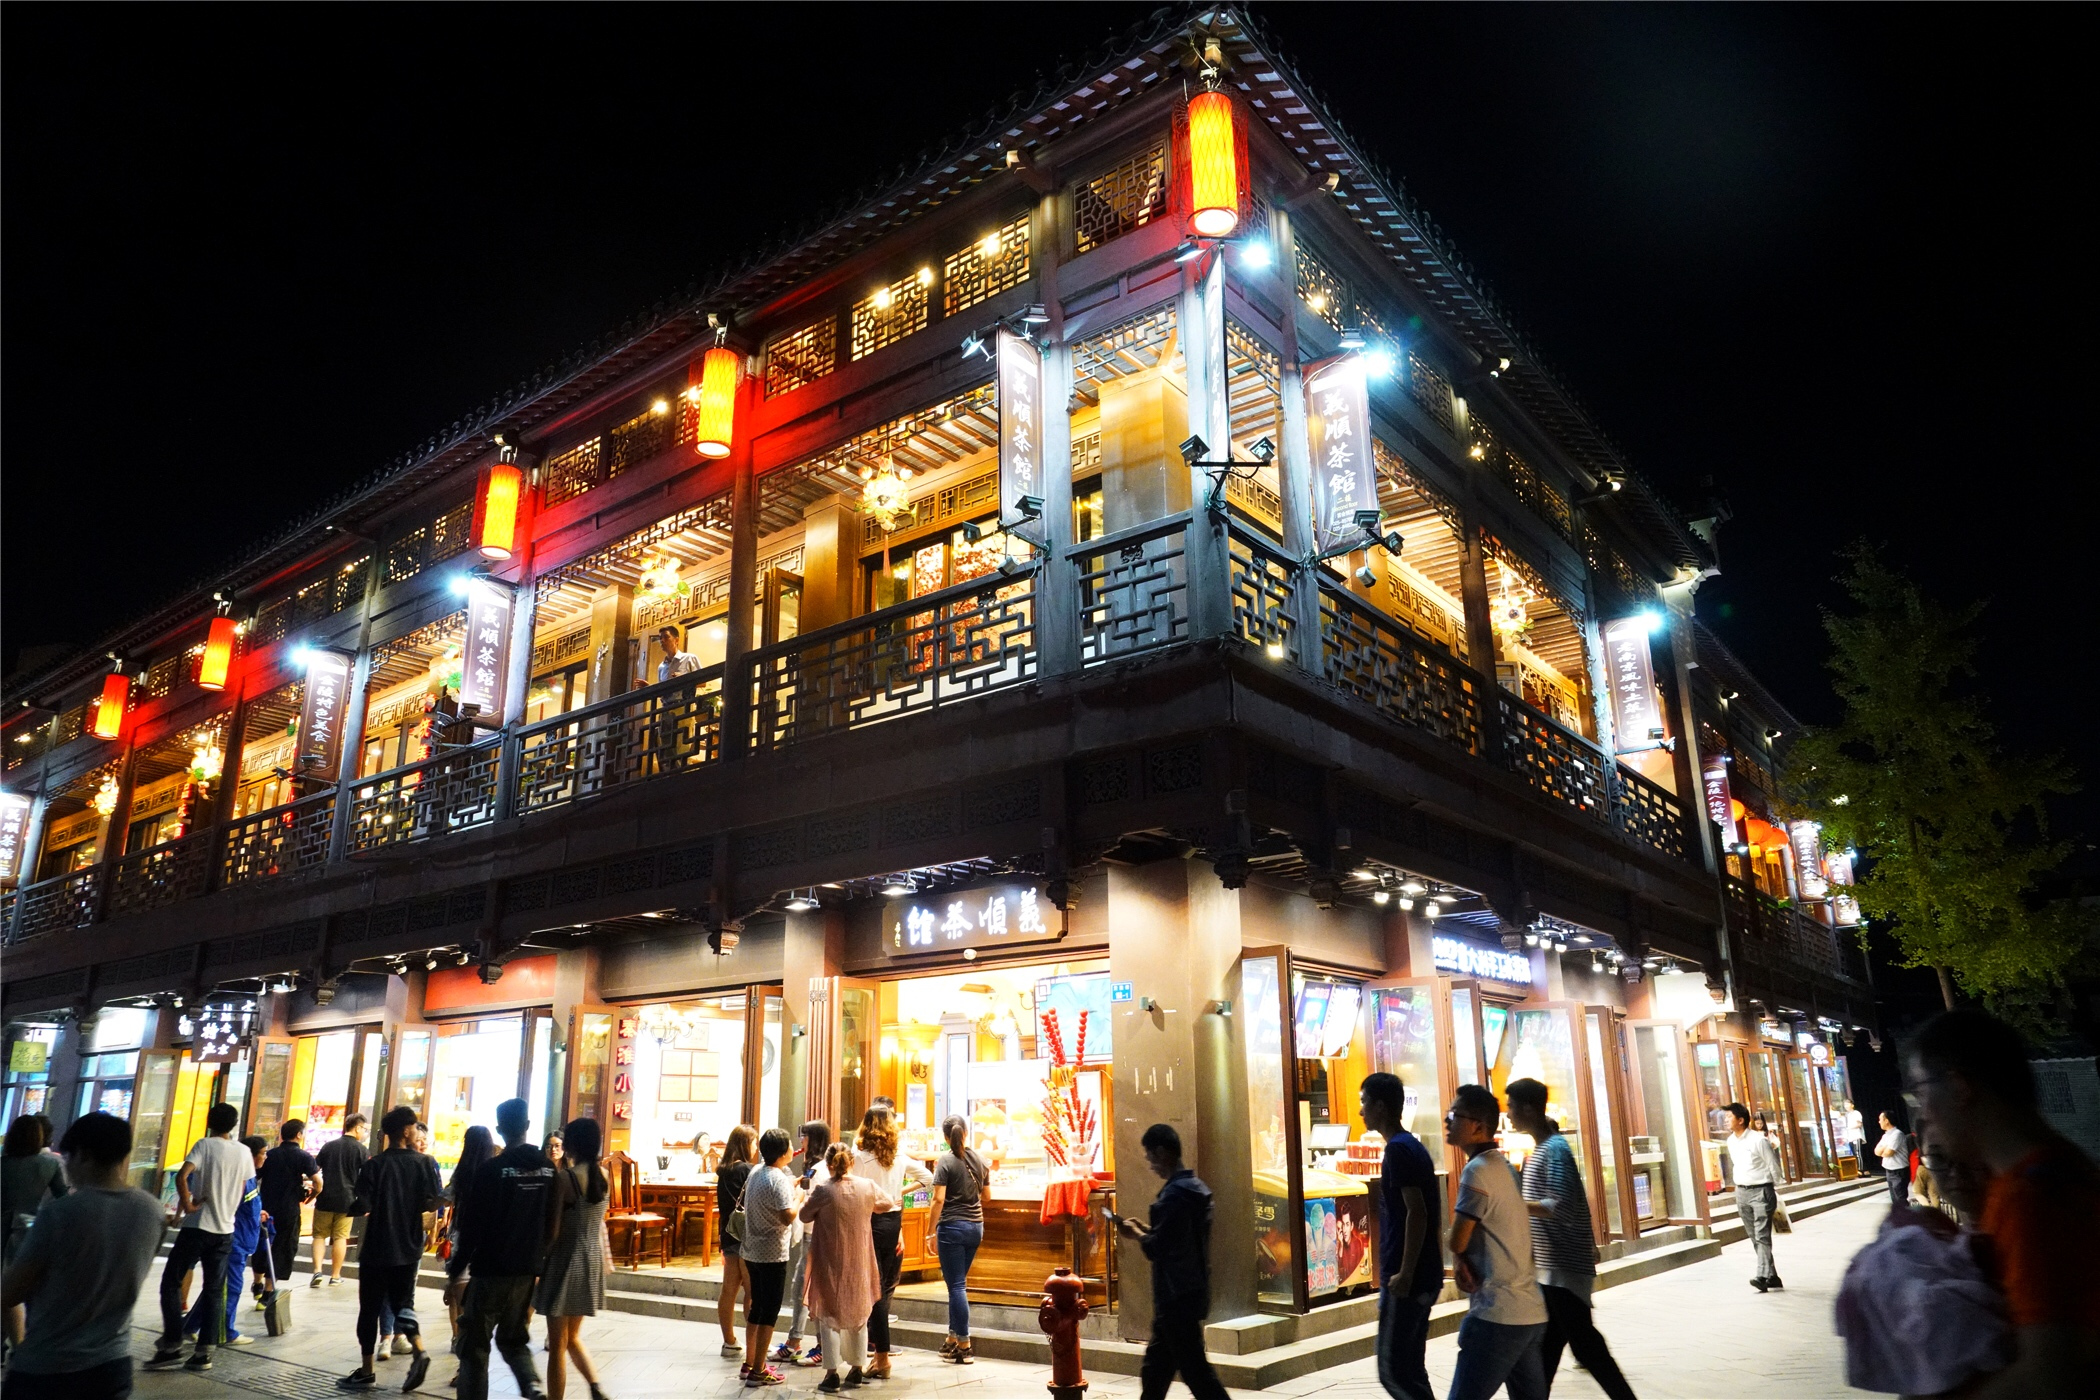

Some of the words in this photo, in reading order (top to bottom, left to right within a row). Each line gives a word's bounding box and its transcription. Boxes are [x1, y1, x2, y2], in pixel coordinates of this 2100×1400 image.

[1012, 371, 1033, 482] 義順茶館
[1322, 388, 1357, 496] 義順茶館
[475, 605, 500, 687] 義順茶館
[613, 1018, 637, 1120] 秦淮小吃
